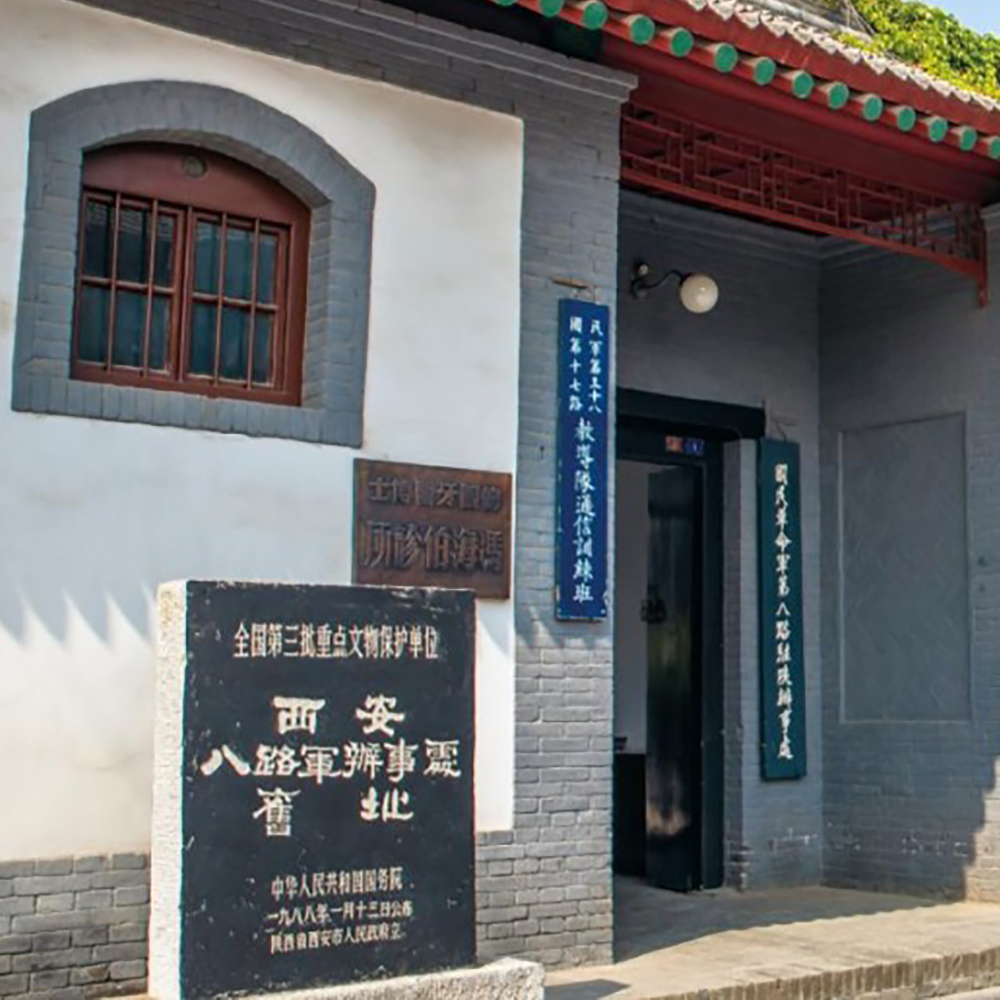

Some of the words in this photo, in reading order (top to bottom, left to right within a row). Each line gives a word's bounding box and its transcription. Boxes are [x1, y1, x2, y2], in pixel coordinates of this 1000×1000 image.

[233, 621, 439, 659] 全国第三批重点文物保护单位
[271, 866, 404, 901] 中华人民共和国国务院
[267, 900, 414, 927] 一九八八年一月十三日公布
[270, 922, 403, 955] 陕西省西安市人民政府立
